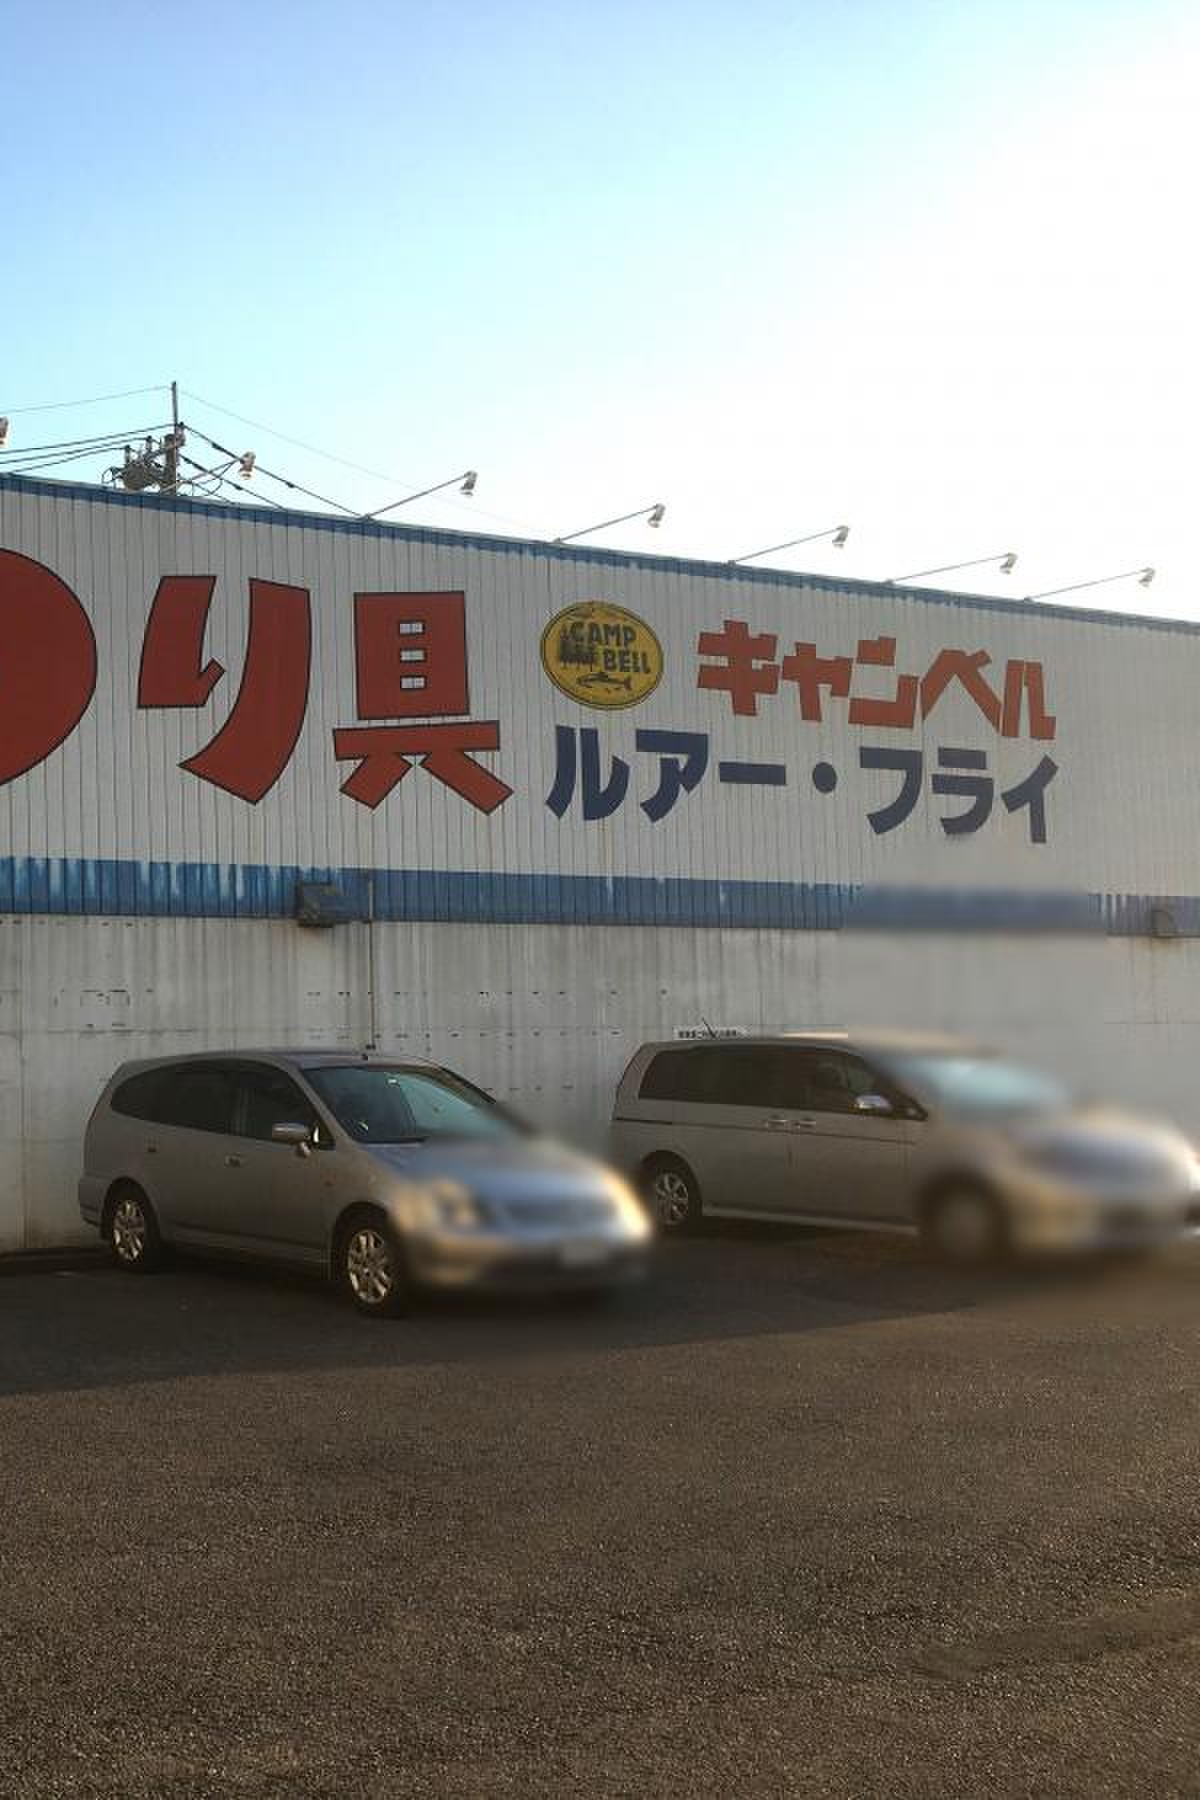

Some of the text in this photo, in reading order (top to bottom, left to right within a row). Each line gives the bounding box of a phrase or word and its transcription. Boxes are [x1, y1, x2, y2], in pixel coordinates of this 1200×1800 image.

[570, 621, 637, 647] CAMP
[603, 648, 651, 675] BELL
[697, 619, 1057, 740] キャンベル
